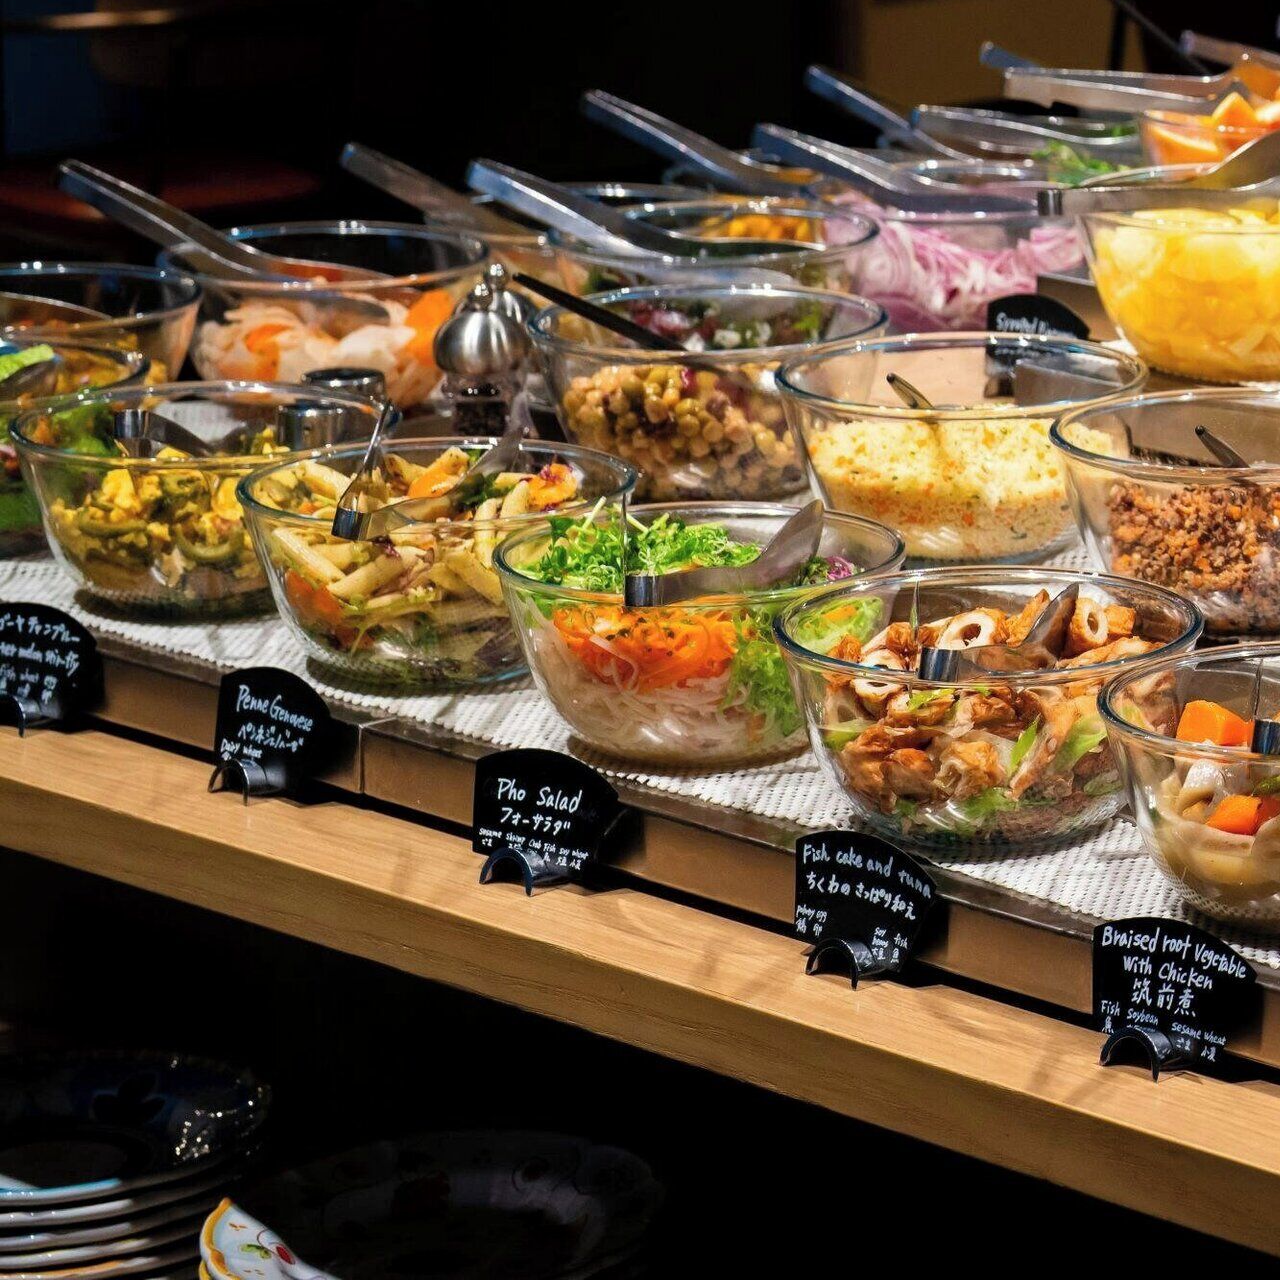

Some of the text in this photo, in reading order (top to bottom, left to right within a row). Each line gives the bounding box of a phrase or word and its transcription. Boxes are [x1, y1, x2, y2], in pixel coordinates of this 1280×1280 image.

[236, 684, 313, 732] Penne Genovese
[498, 778, 582, 813] Pho Salad
[500, 807, 571, 836] フォーサラダ
[803, 843, 931, 899] Fish cake and tuna
[1102, 926, 1160, 952] Braised
[1162, 935, 1191, 959] root
[1158, 962, 1213, 989] Chicken
[1101, 1000, 1120, 1016] Fish
[1127, 1008, 1158, 1025] Soybean
[1131, 978, 1196, 1017] 筑前煮
